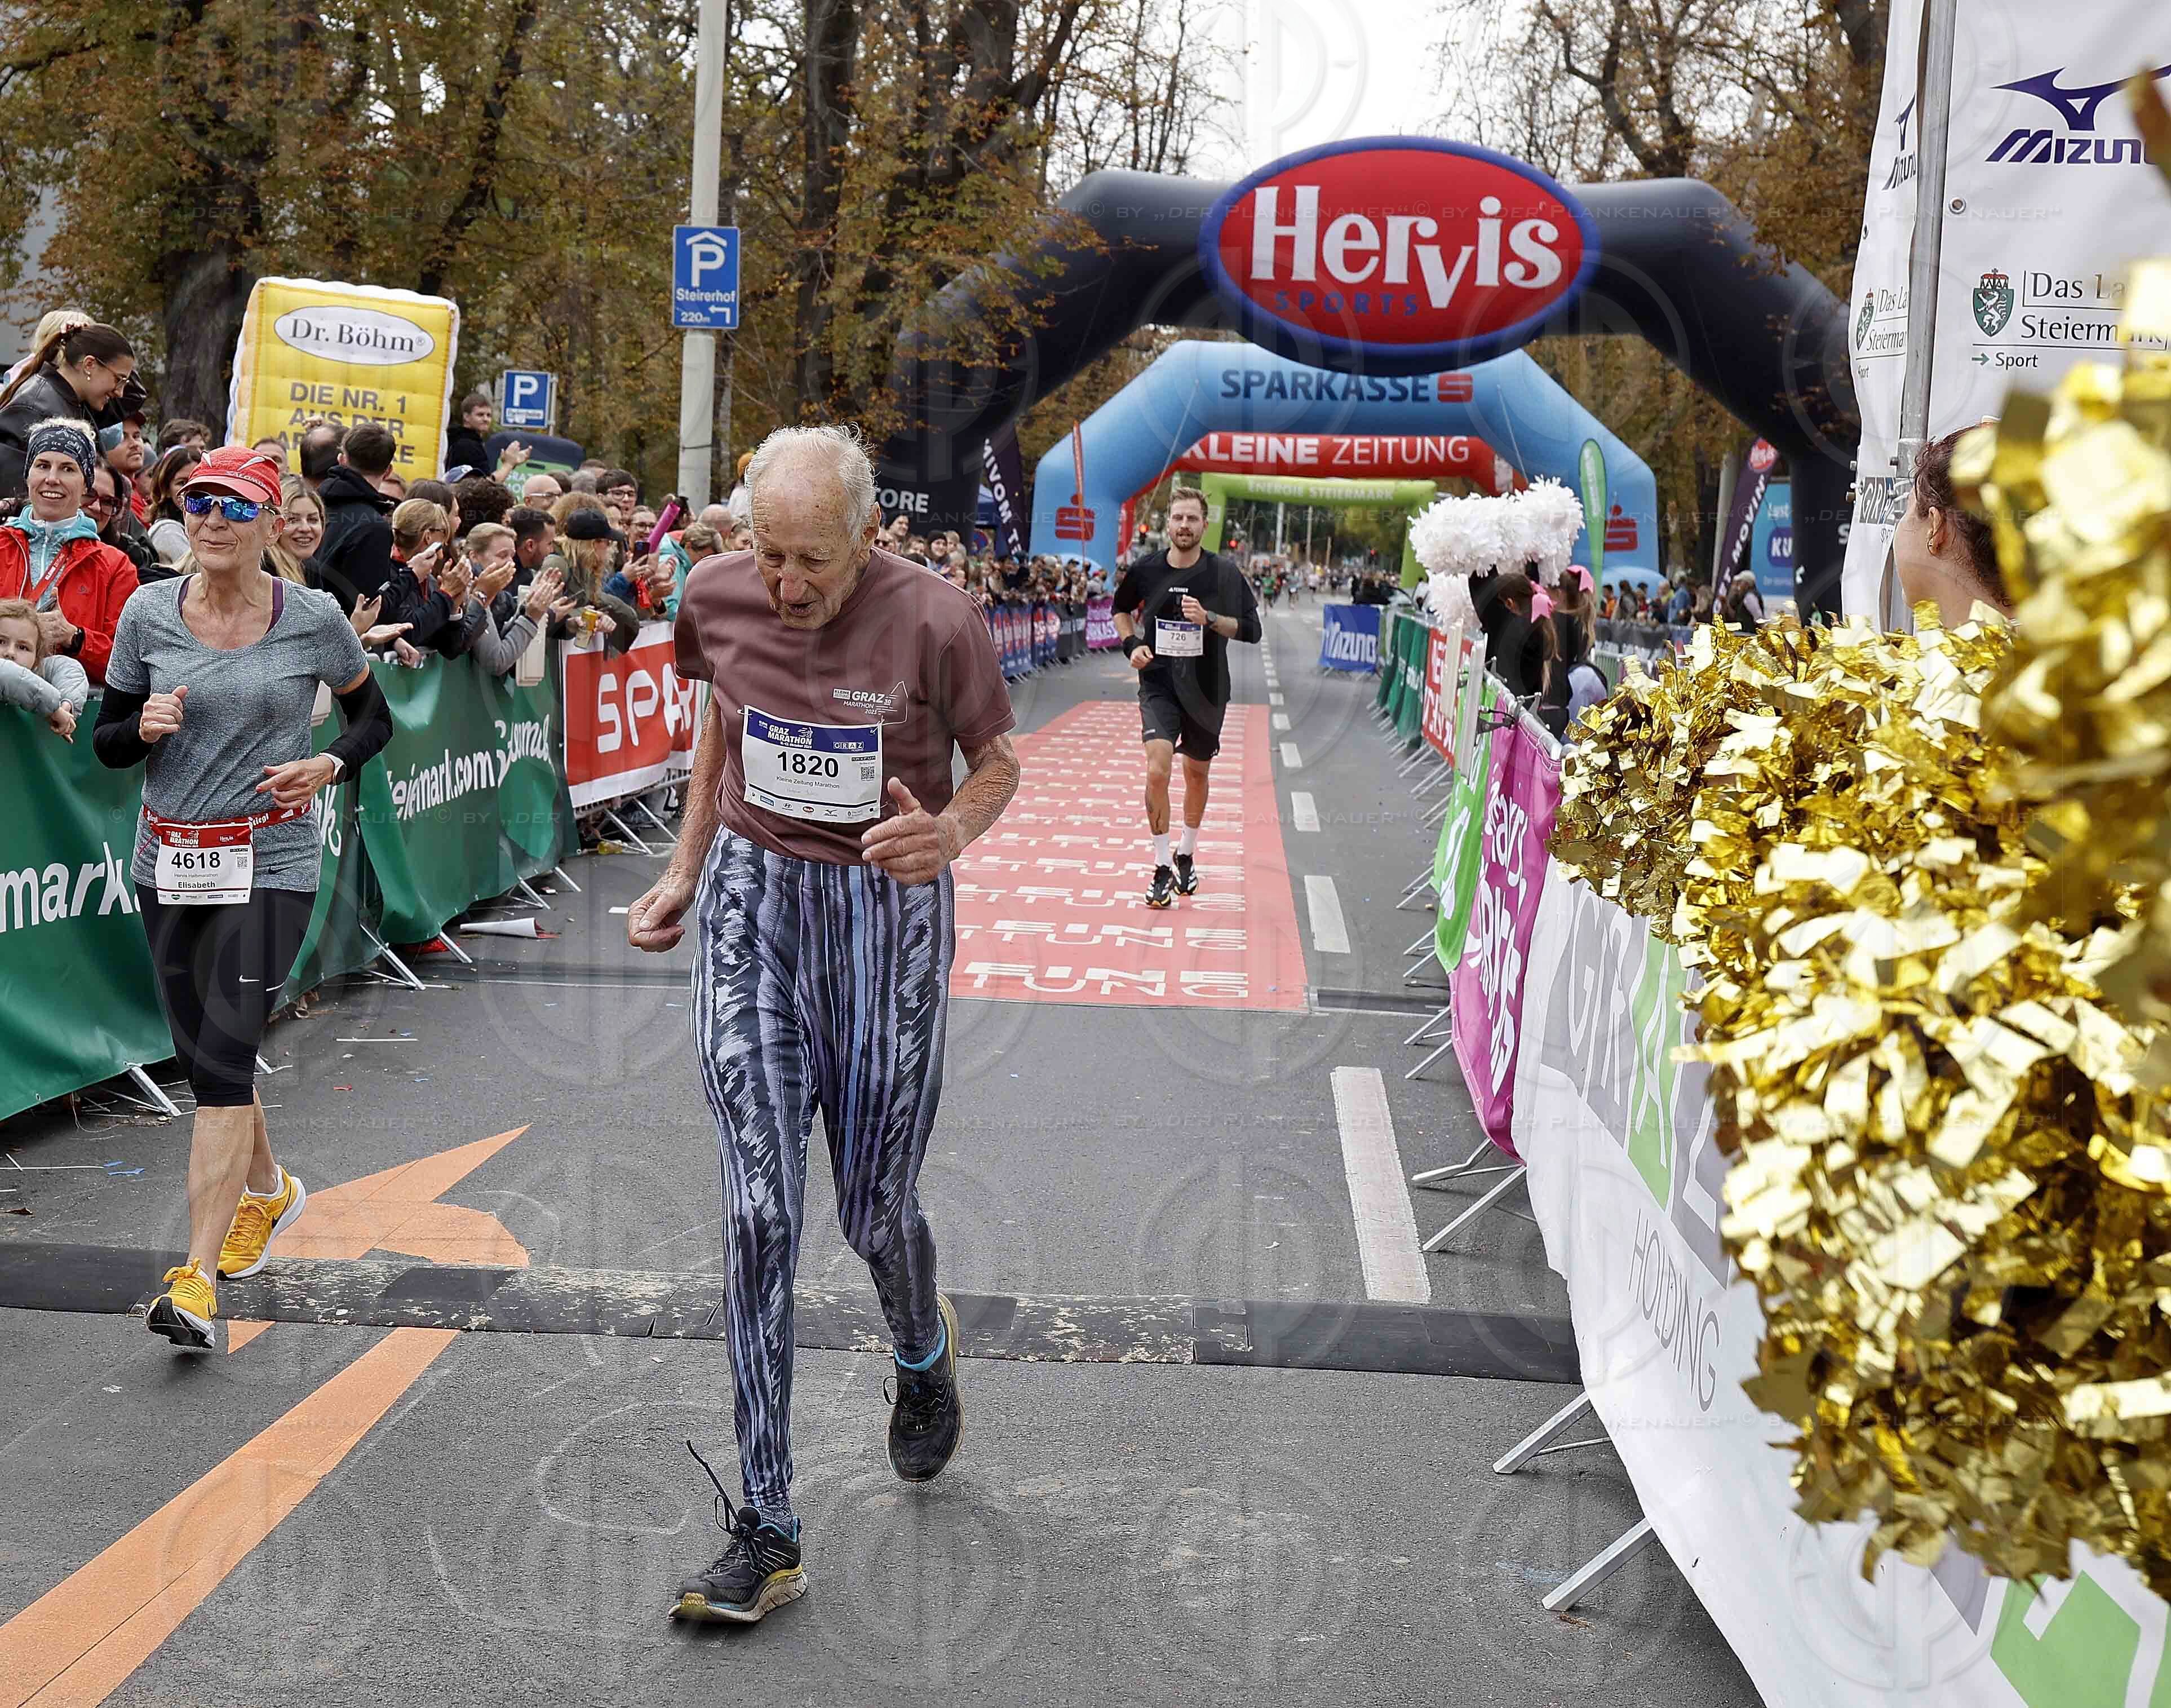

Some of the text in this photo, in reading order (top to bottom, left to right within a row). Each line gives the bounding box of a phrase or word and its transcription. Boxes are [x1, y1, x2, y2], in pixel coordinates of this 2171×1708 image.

[1250, 184, 1562, 309] Hervis
[676, 287, 736, 302] Steirerhof
[1879, 286, 1908, 312] Das La
[2031, 273, 2126, 299] Das La
[1274, 290, 1419, 316] SPORTS
[291, 318, 329, 342] Dr.
[1866, 328, 1908, 351] Steierma
[2021, 315, 2163, 347] Steierm
[1995, 352, 2038, 370] Sport
[290, 382, 406, 414] DIE NR. 1
[513, 375, 539, 407] P
[1221, 369, 1430, 402] SPARKASSE
[1332, 436, 1469, 464] ZEITUNG
[875, 487, 930, 514] ORE
[1309, 486, 1394, 501] STEIERMARK
[1171, 632, 1186, 641] 726
[1324, 621, 1377, 663] MIZUNO
[852, 691, 885, 703] GRAZ
[768, 731, 812, 745] MARATHON
[769, 725, 789, 735] GRAZ
[777, 751, 839, 778] 1820
[793, 778, 814, 787] Zeitung
[171, 852, 221, 869] 4618
[1628, 1208, 1721, 1412] HOLDING
